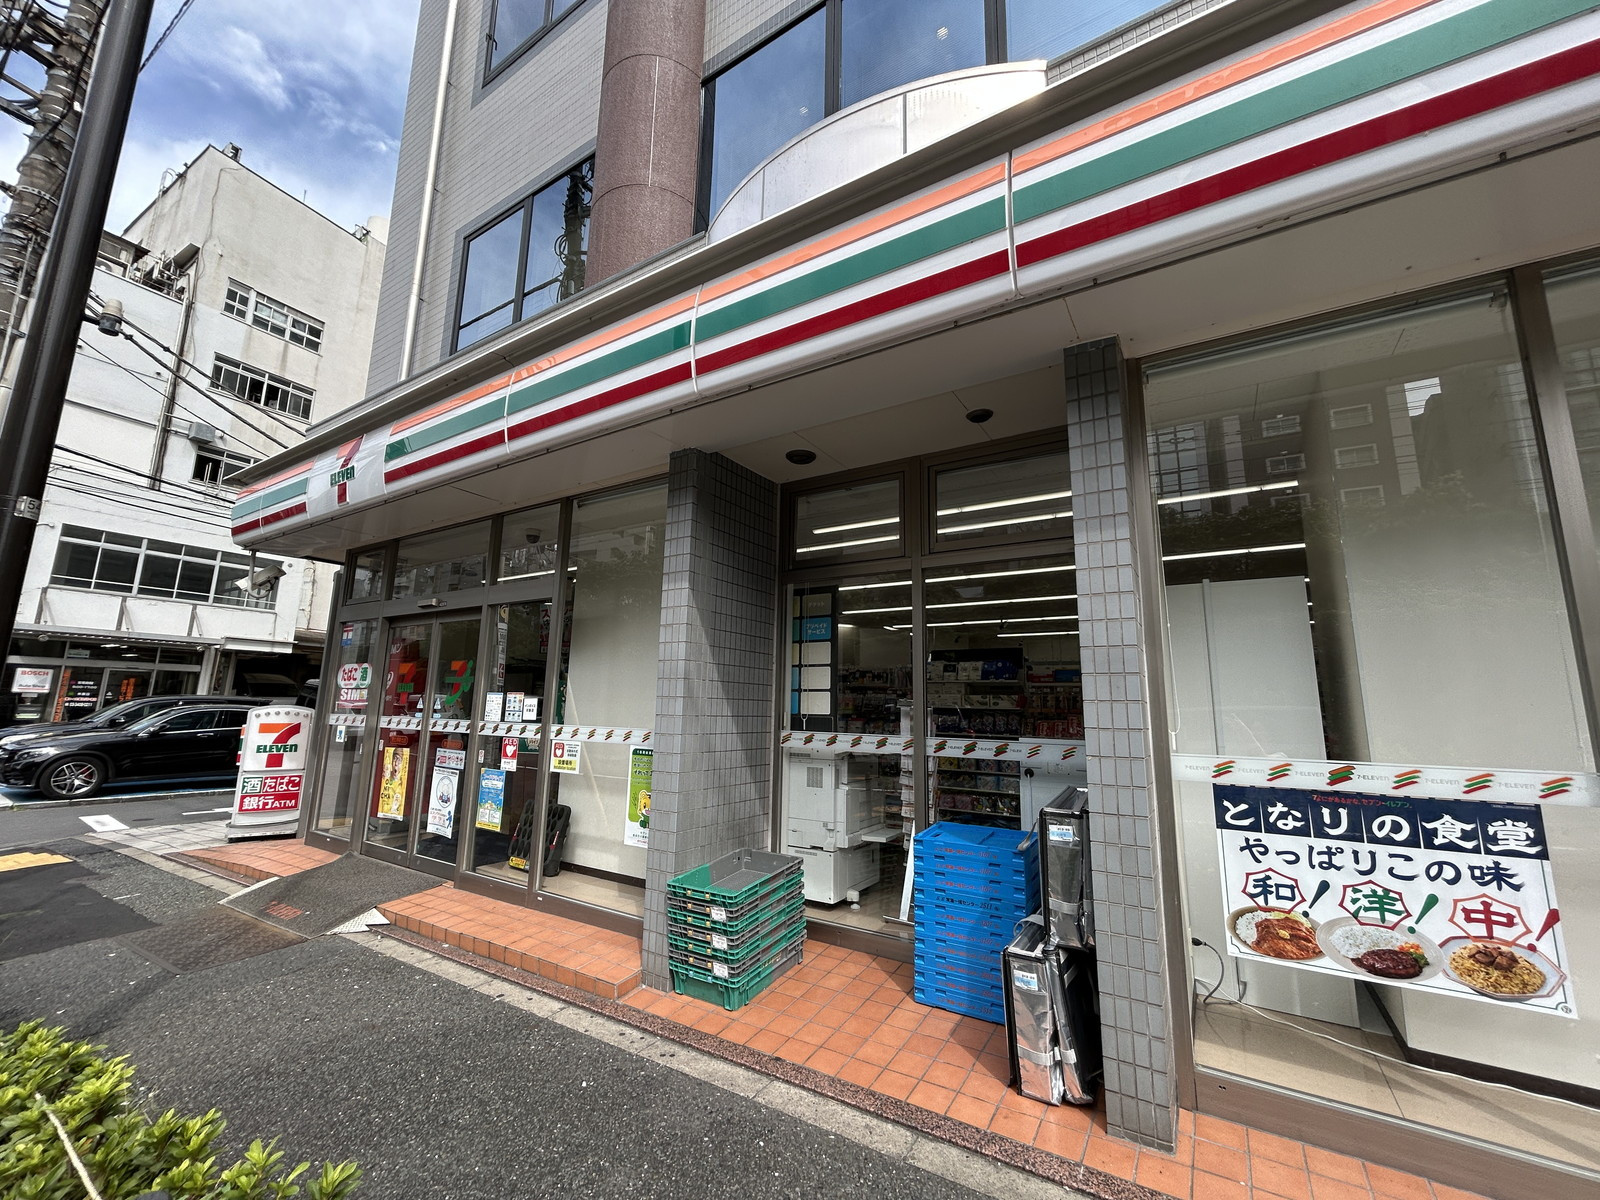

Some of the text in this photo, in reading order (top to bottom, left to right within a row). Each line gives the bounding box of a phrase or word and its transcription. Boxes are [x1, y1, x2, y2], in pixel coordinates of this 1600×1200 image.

[329, 433, 365, 505] 7 ELEVEN
[340, 666, 369, 682] たばこ 酒
[255, 722, 302, 768] 7 ELEVEN
[242, 778, 263, 793] 酒
[263, 776, 300, 792] たばこ
[1356, 774, 1390, 783] 7-ELEVEN
[241, 795, 296, 810] 銀行ATM
[1221, 798, 1543, 856] となりの食堂
[1239, 836, 1526, 893] やっぱりこの味
